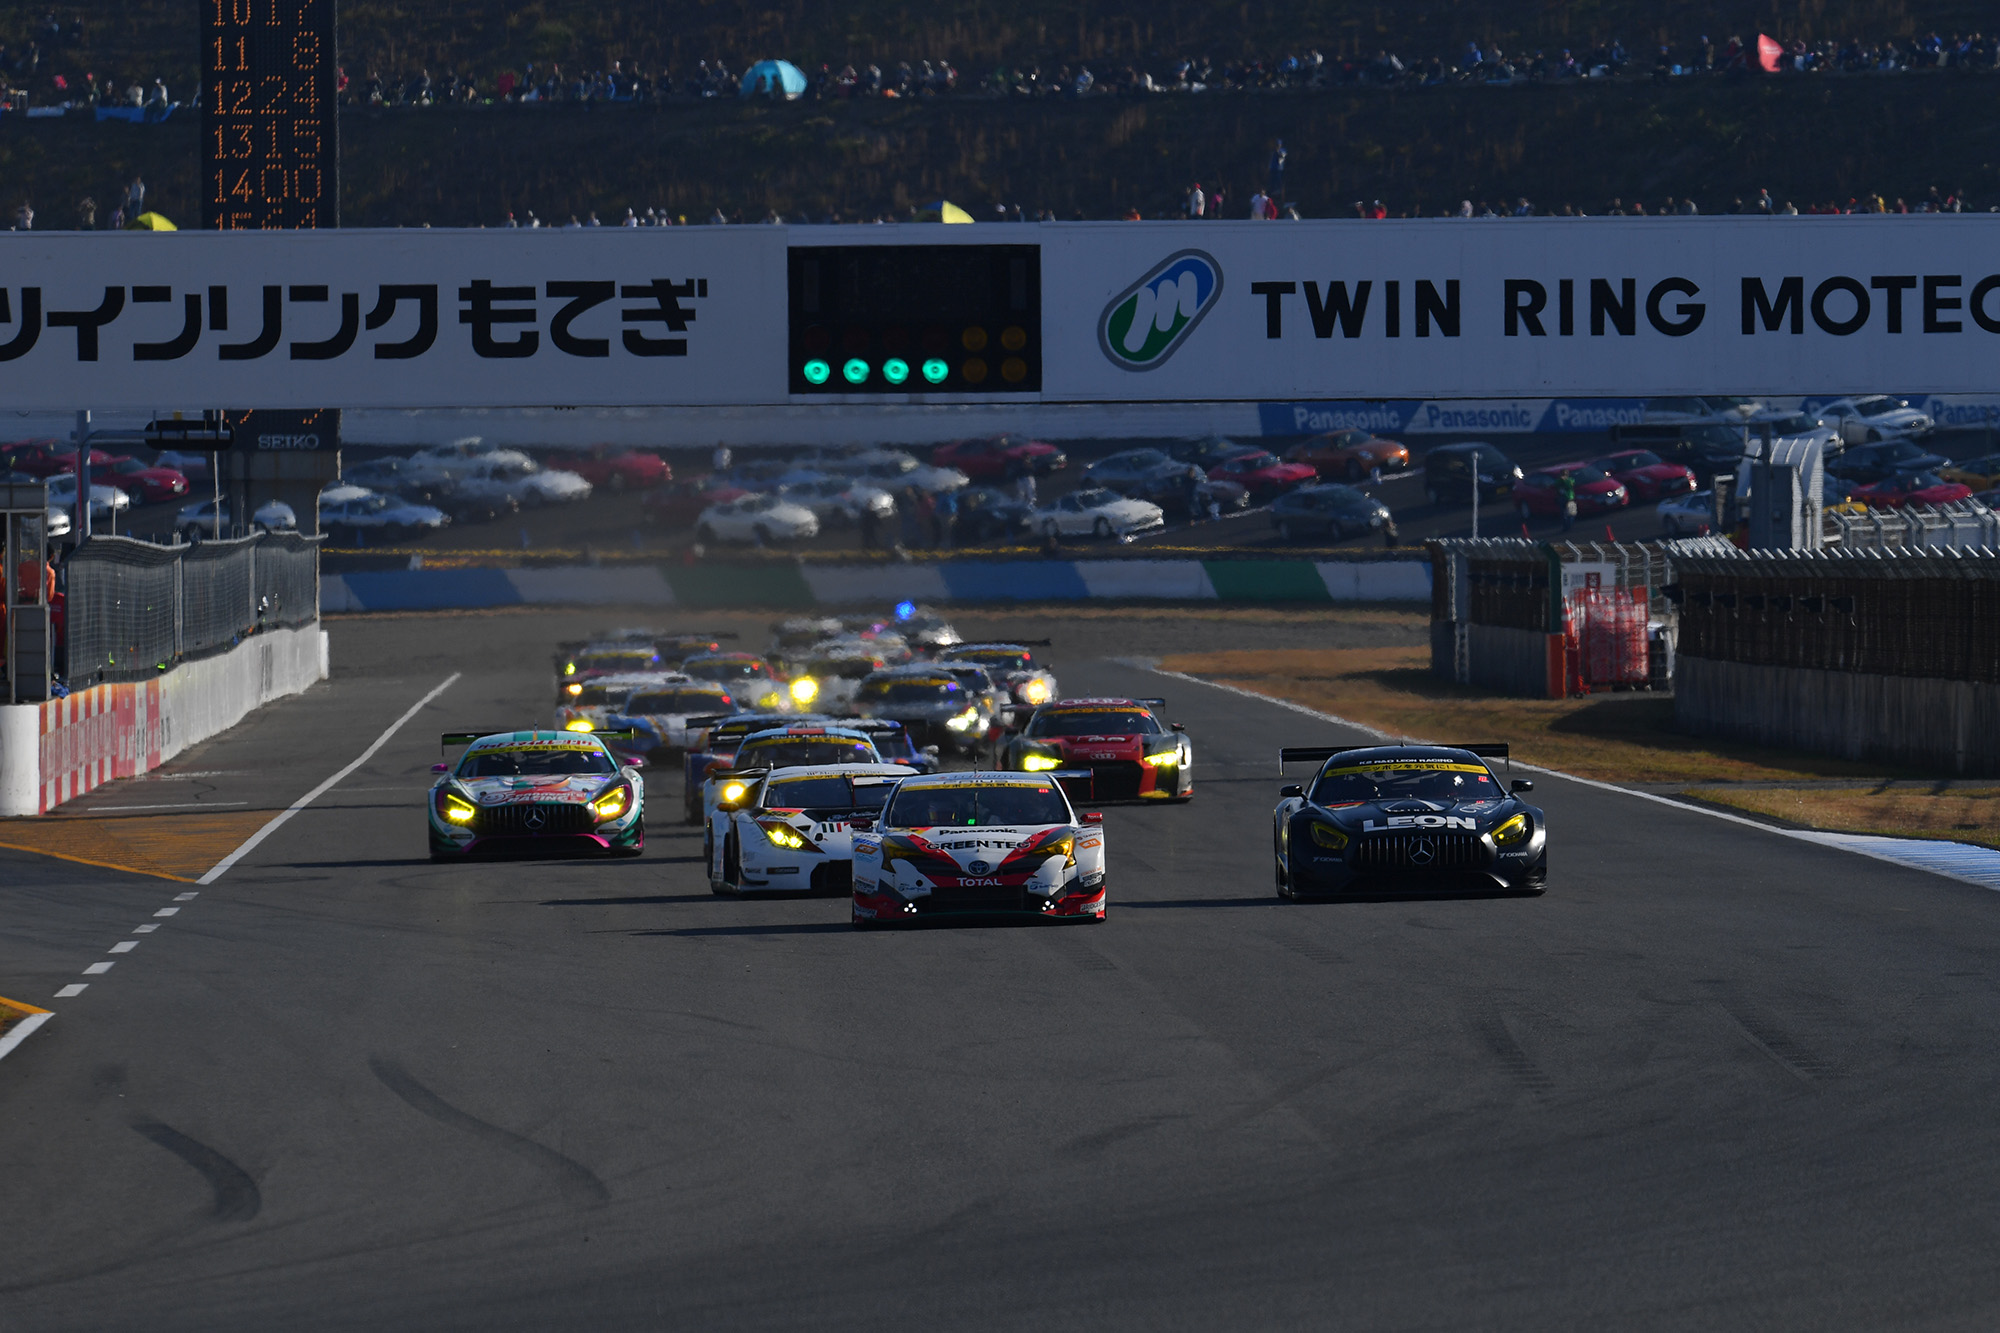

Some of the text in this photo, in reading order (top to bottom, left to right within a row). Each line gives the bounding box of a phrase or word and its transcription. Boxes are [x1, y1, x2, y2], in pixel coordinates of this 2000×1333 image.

[213, 31, 320, 71] 11 8
[213, 75, 320, 115] 12 24
[213, 120, 321, 159] 13 15
[213, 163, 322, 203] 14 00
[1251, 279, 1460, 339] TWIN
[1504, 276, 1706, 337] RING
[1293, 404, 1400, 430] Panasonic
[1426, 403, 1531, 428] Panasonic
[1556, 402, 1646, 427] Panasoni
[258, 433, 319, 449] SEIKO
[939, 828, 1018, 836] Panasonic
[1363, 815, 1477, 832] LEON
[926, 840, 989, 850] GREEN
[957, 877, 1003, 887] TOTAL
